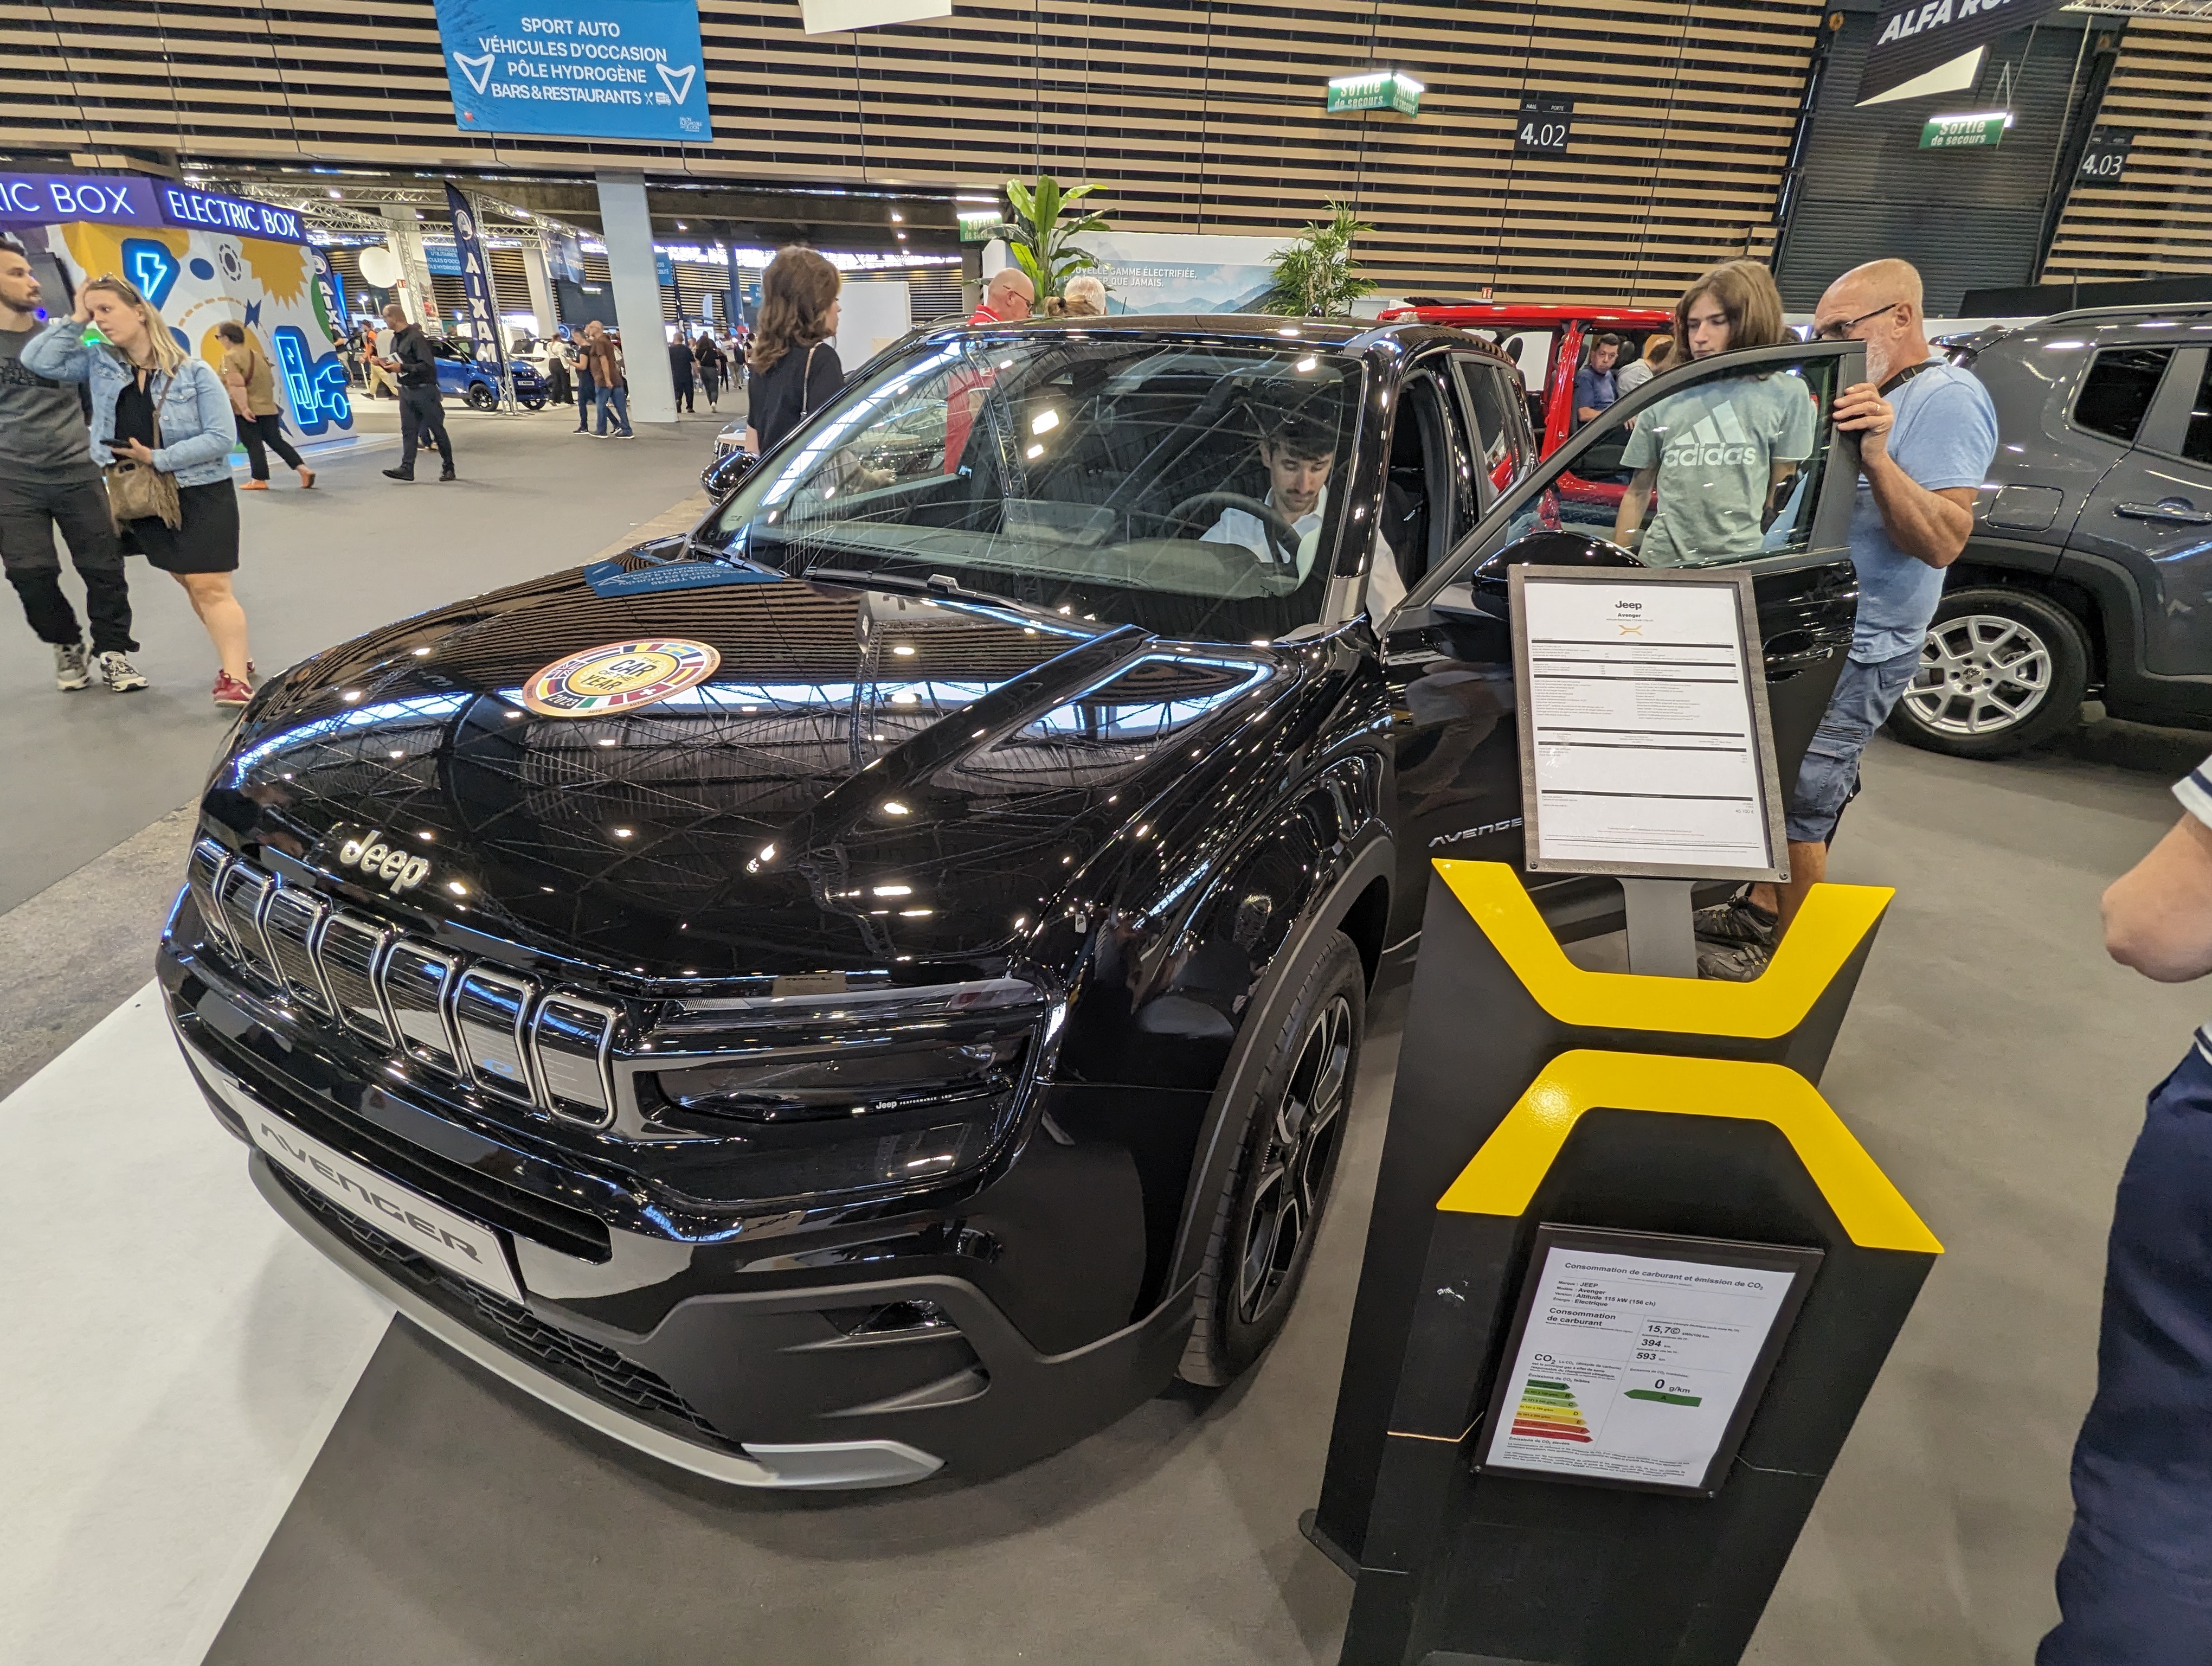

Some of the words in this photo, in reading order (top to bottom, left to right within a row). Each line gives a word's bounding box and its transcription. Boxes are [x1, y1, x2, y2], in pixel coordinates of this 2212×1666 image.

[521, 17, 574, 35] SPORT
[578, 20, 620, 37] AUTO
[1876, 0, 1952, 45] ALFA
[479, 35, 568, 57] VÉHICULES
[570, 43, 667, 62] D'OCCASION
[507, 59, 548, 78] PÔLE
[551, 63, 647, 83] HYDROGÈNE
[1340, 81, 1381, 97] Sortie
[1397, 82, 1415, 102] Sortie
[1335, 99, 1345, 109] de
[1348, 95, 1383, 108] secours
[1393, 94, 1399, 106] de
[1399, 99, 1415, 116] secours
[1520, 123, 1565, 146] 4.02
[1939, 121, 1986, 136] Sortie
[1931, 136, 1943, 146] de
[1946, 134, 1987, 145] secours
[2082, 154, 2123, 176] 4.03
[0, 183, 40, 212] IC
[50, 184, 135, 214] BOX
[169, 190, 260, 231] ELECTRIC
[264, 210, 300, 238] BOX
[964, 230, 972, 239] de
[1071, 267, 1108, 275] OUVELLE
[1111, 268, 1141, 277] GAMME
[1143, 266, 1197, 279] ÉLECTRIFIÉE,
[1130, 279, 1164, 287] JAMAIS.
[465, 252, 498, 362] AIXAM
[1663, 443, 1756, 467] adidas
[1615, 600, 1642, 610] Jeep
[609, 659, 657, 677] CAR
[643, 656, 661, 664] THE
[581, 674, 622, 691] YEAR
[613, 673, 634, 682] THE
[548, 694, 580, 706] 2023
[1428, 817, 1522, 848] AVENGE
[340, 830, 430, 894] Jeep
[876, 1101, 897, 1109] Jeep
[899, 1097, 937, 1105] PERFORMANCE
[261, 1123, 483, 1264] AVENGER
[1565, 1263, 1627, 1274] Consommation
[1642, 1270, 1683, 1280] carburant
[1694, 1276, 1732, 1286] émission
[1574, 1298, 1608, 1307] Electrique
[1549, 1308, 1616, 1320] Consommation
[1560, 1317, 1603, 1327] carburant
[1641, 1339, 1662, 1347] 394
[1636, 1352, 1656, 1360] 593
[1655, 1379, 1665, 1389] 0
